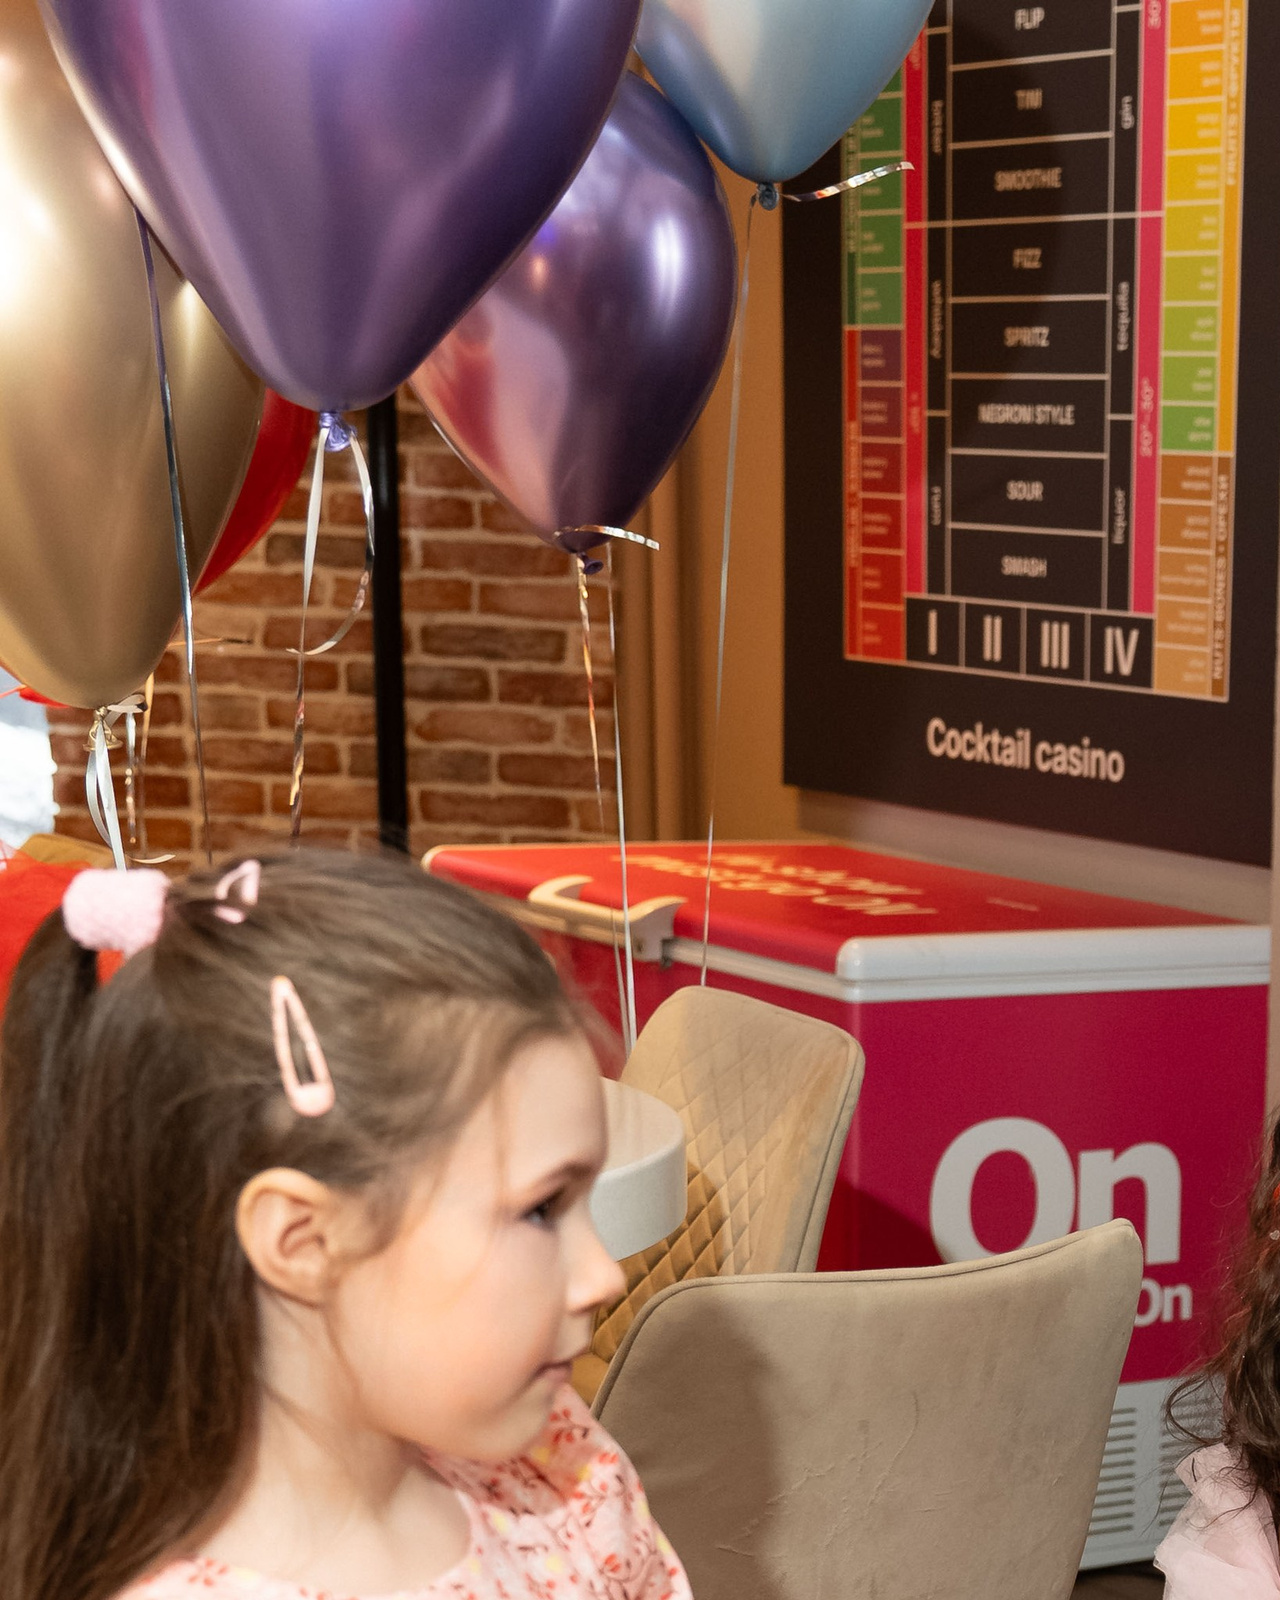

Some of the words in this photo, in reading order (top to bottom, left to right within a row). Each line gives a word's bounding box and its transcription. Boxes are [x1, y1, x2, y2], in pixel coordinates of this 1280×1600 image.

[1014, 6, 1046, 31] FLIP
[1120, 95, 1135, 130] gin
[994, 167, 1063, 192] SMOOTHIE
[1012, 247, 1043, 270] FIZZ
[1003, 325, 1050, 348] SPRITZ
[1116, 281, 1131, 352] tequila
[1034, 404, 1076, 427] STYLE
[930, 485, 942, 526] rum
[1006, 480, 1045, 502] SOUR
[1001, 555, 1048, 579] SMASH
[928, 609, 938, 656] I
[983, 614, 1003, 662] II
[1041, 620, 1071, 670] III
[1103, 625, 1140, 677] IV
[926, 716, 1032, 770] Cocktail
[1034, 736, 1126, 784] casino
[928, 1115, 1183, 1266] On
[1133, 1278, 1194, 1328] On
